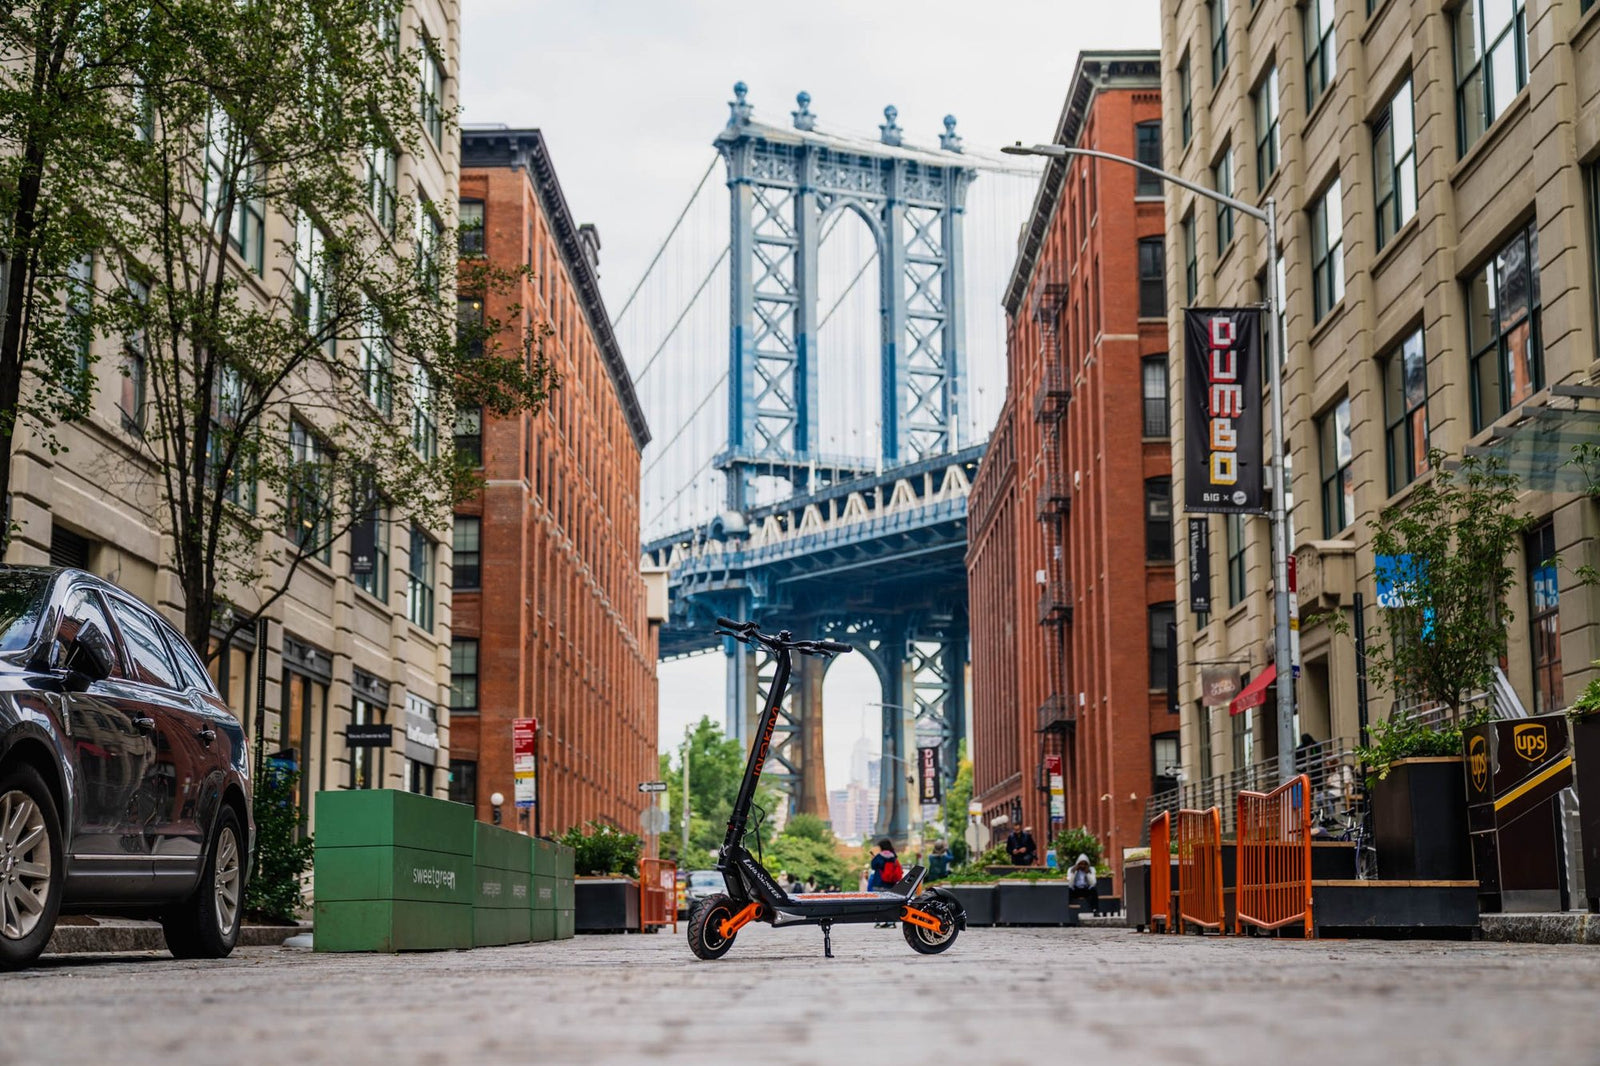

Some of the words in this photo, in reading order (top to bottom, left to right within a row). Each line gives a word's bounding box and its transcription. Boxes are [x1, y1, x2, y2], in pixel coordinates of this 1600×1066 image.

[1209, 317, 1242, 485] DUMBO
[1203, 493, 1220, 502] BIG
[1517, 735, 1545, 755] ups
[1472, 752, 1486, 784] ups
[412, 866, 456, 891] sweetgreen
